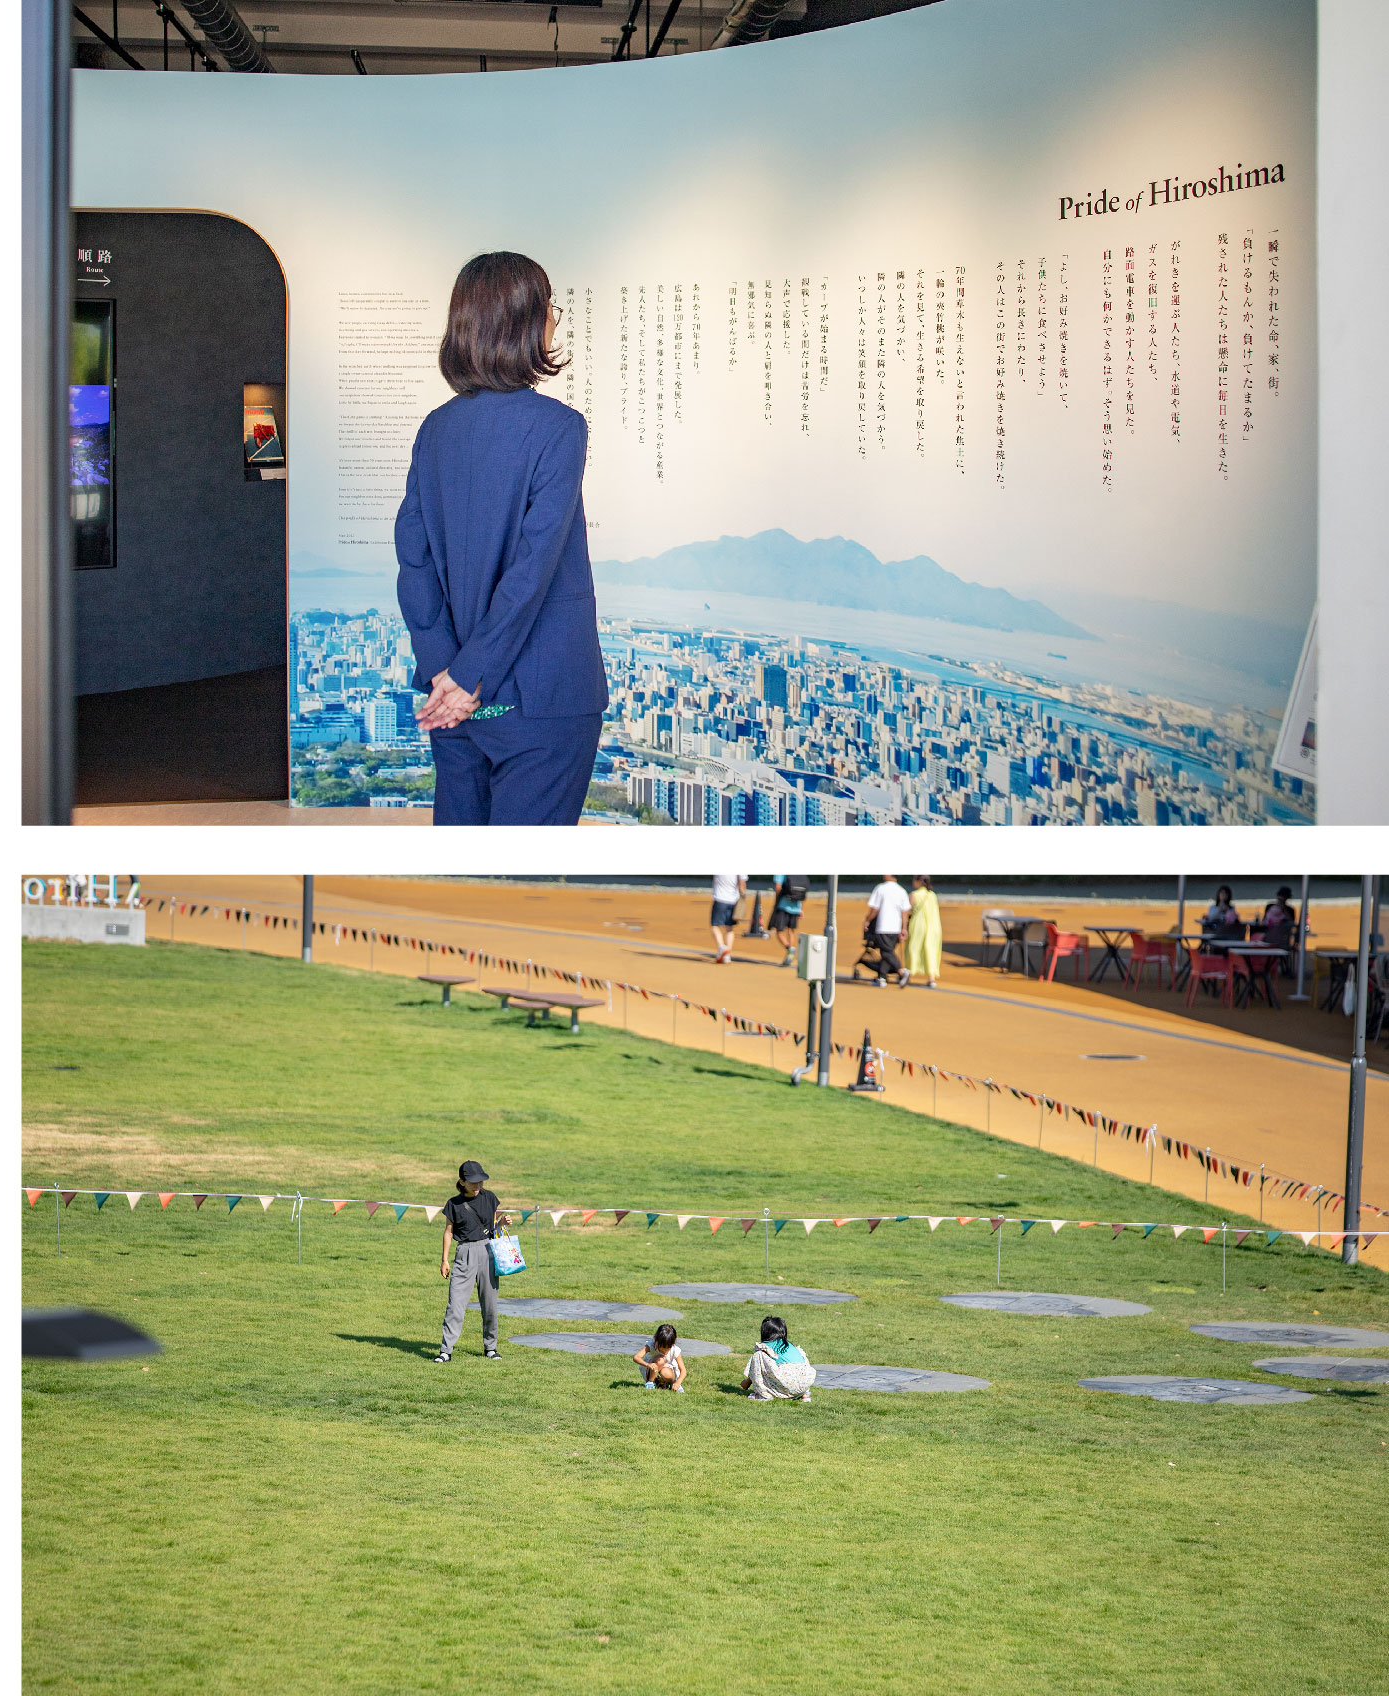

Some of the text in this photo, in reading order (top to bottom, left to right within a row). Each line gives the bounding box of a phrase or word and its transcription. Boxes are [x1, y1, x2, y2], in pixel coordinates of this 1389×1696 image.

[77, 248, 113, 264] 順路
[1059, 162, 1286, 221] Pride of Hiroshima
[876, 272, 886, 451] 隣の人がそのまた隣の人を気づかう。
[895, 270, 906, 363] 隣の人を気づかい、
[915, 269, 926, 458] それを見て、生きる希望を取り戻した。
[995, 261, 1006, 491] その人はこの街でお好み焼きを焼き続けた。
[1015, 259, 1027, 384] それから長きにわたり、
[1057, 253, 1070, 409] 「よし、お好み焼きを焼いて、
[1102, 248, 1113, 493] 自分にも何かできるはず。そう思い始めた。
[1124, 246, 1135, 435] 路面電車を動かす人たちを見た。
[1146, 243, 1158, 381] ガスを復旧する人たち、
[1168, 240, 1182, 444] がれきを運ぶ人たち、水道や電気、
[1216, 232, 1230, 481] 残された人たちは懸命に毎日を生きた。
[1239, 229, 1254, 441] 「負けるもんか、負けてたまるか」
[1266, 229, 1280, 397] 一瞬で失われた命、家、街。
